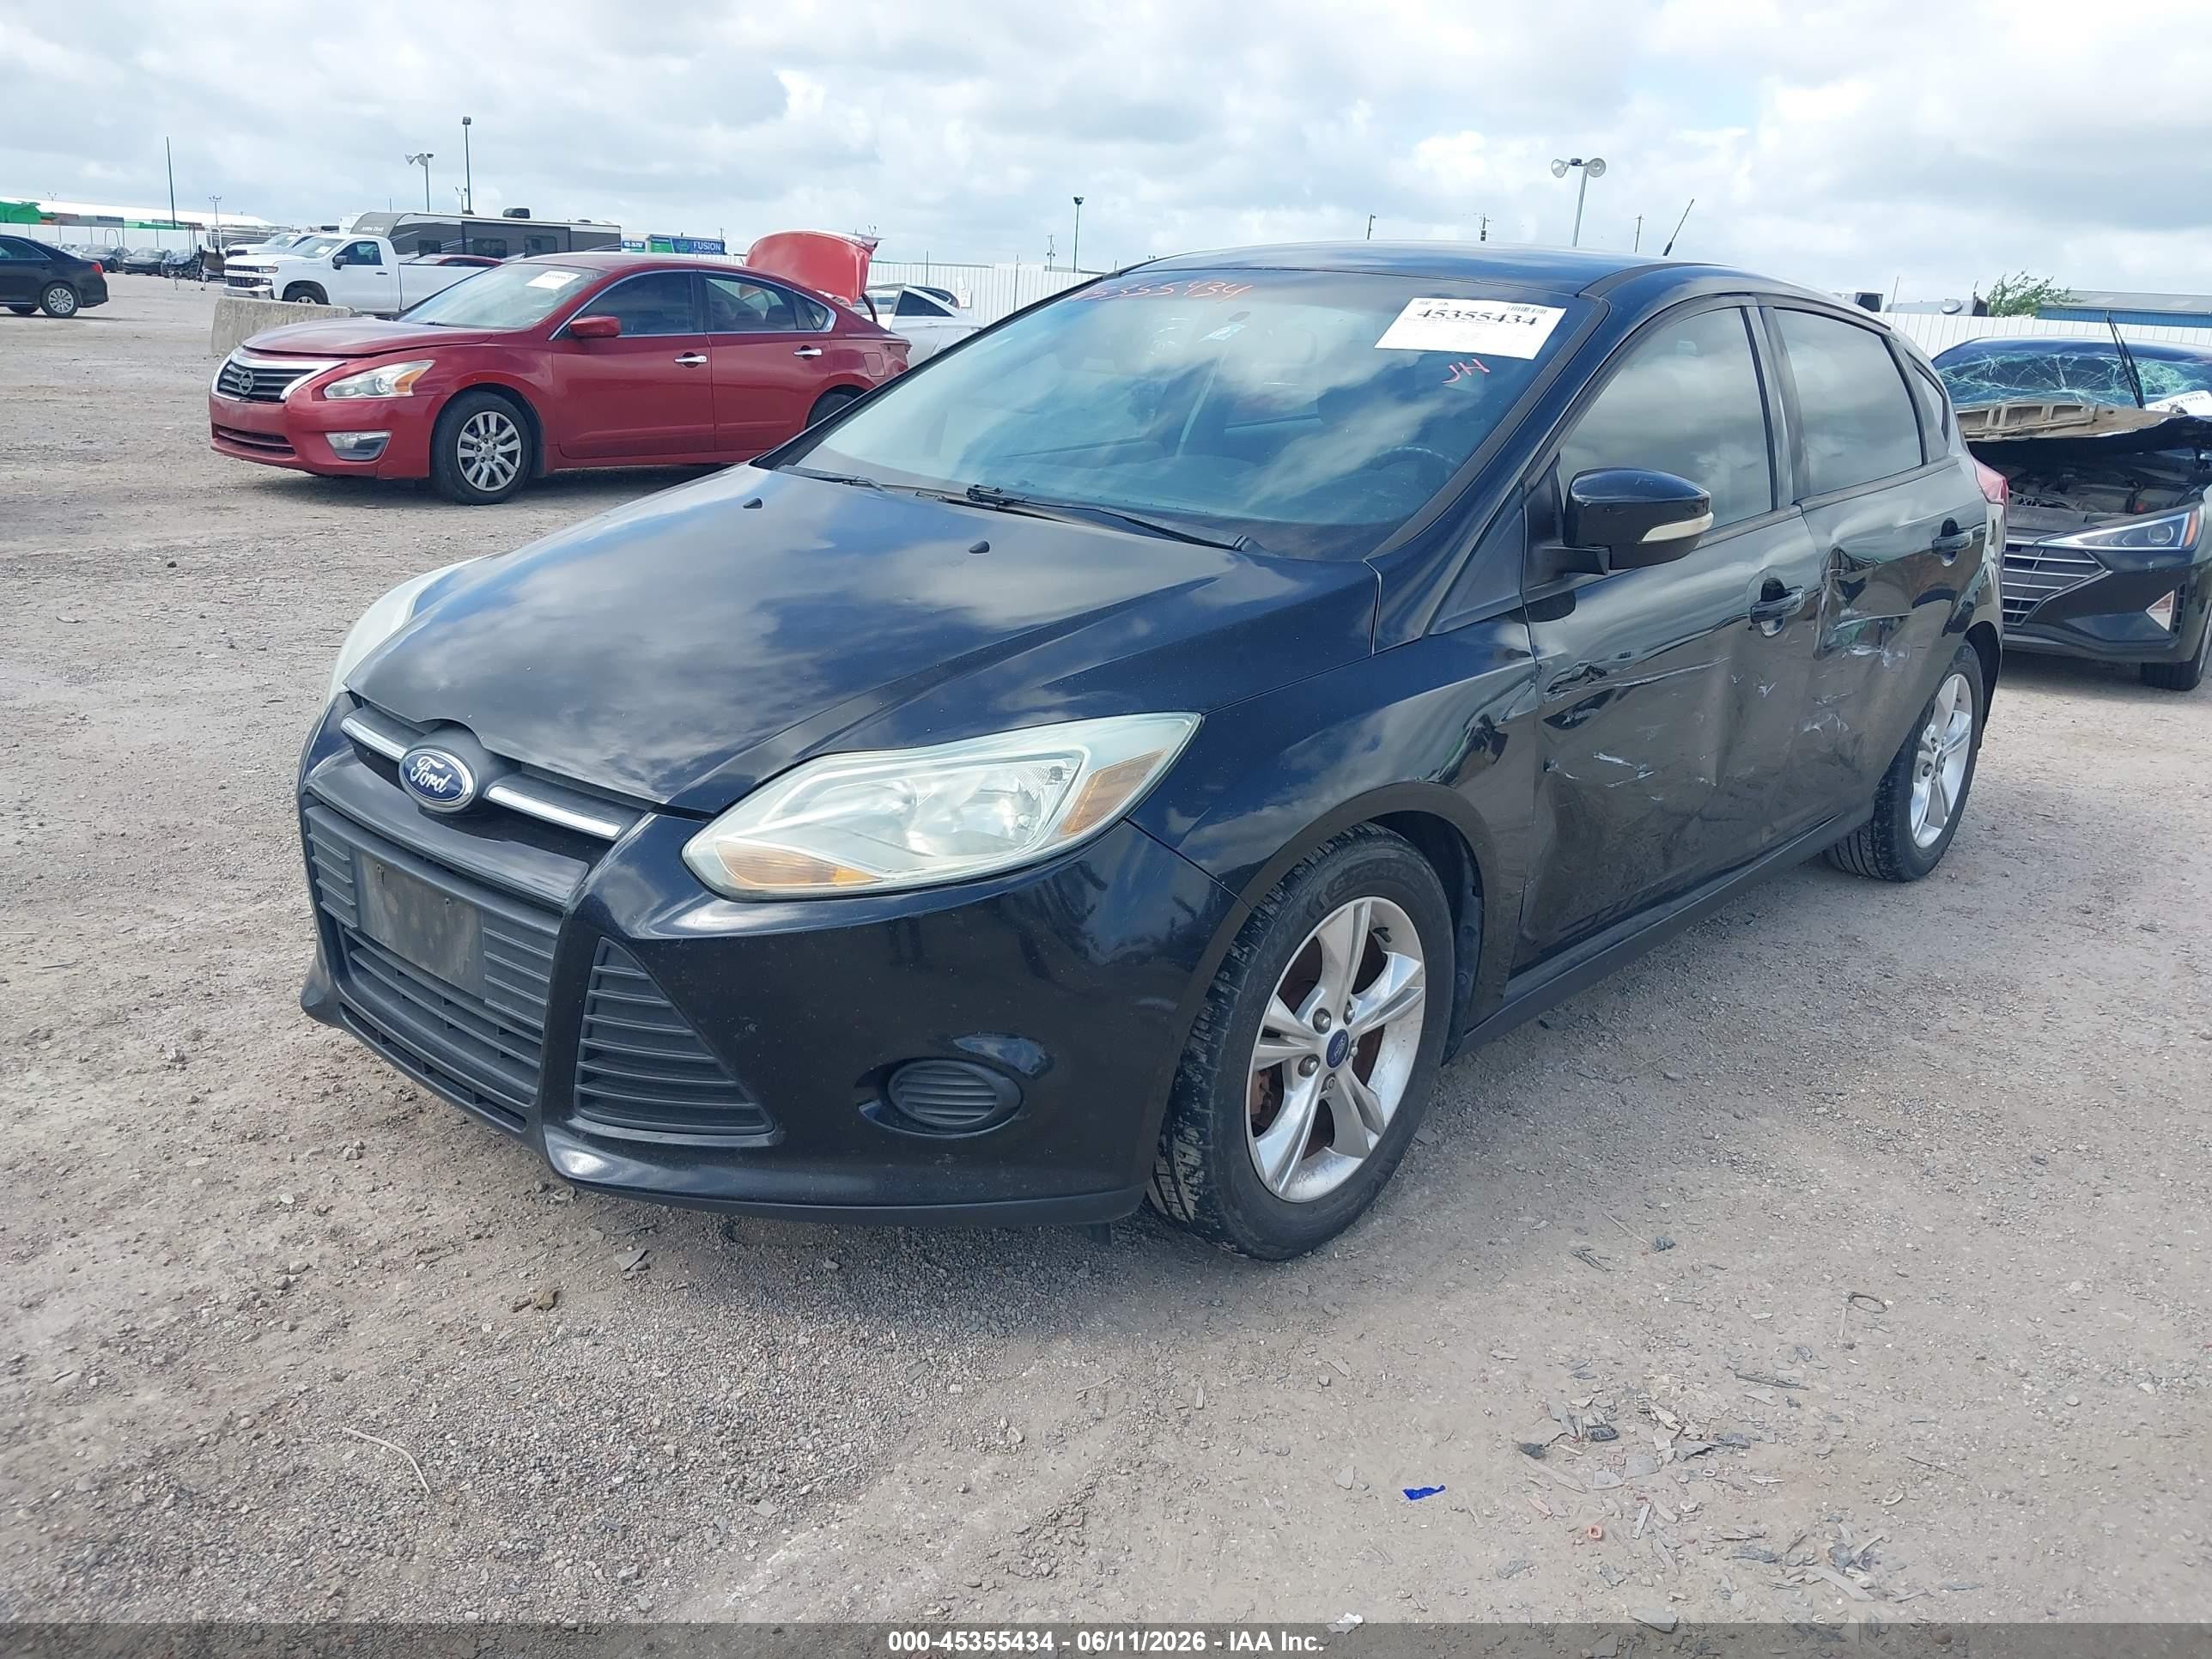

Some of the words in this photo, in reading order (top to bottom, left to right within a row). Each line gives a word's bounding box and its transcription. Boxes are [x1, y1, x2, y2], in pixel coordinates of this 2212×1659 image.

[693, 241, 721, 251] FUSION
[1417, 308, 1538, 325] 45355434
[410, 756, 453, 793] Ford
